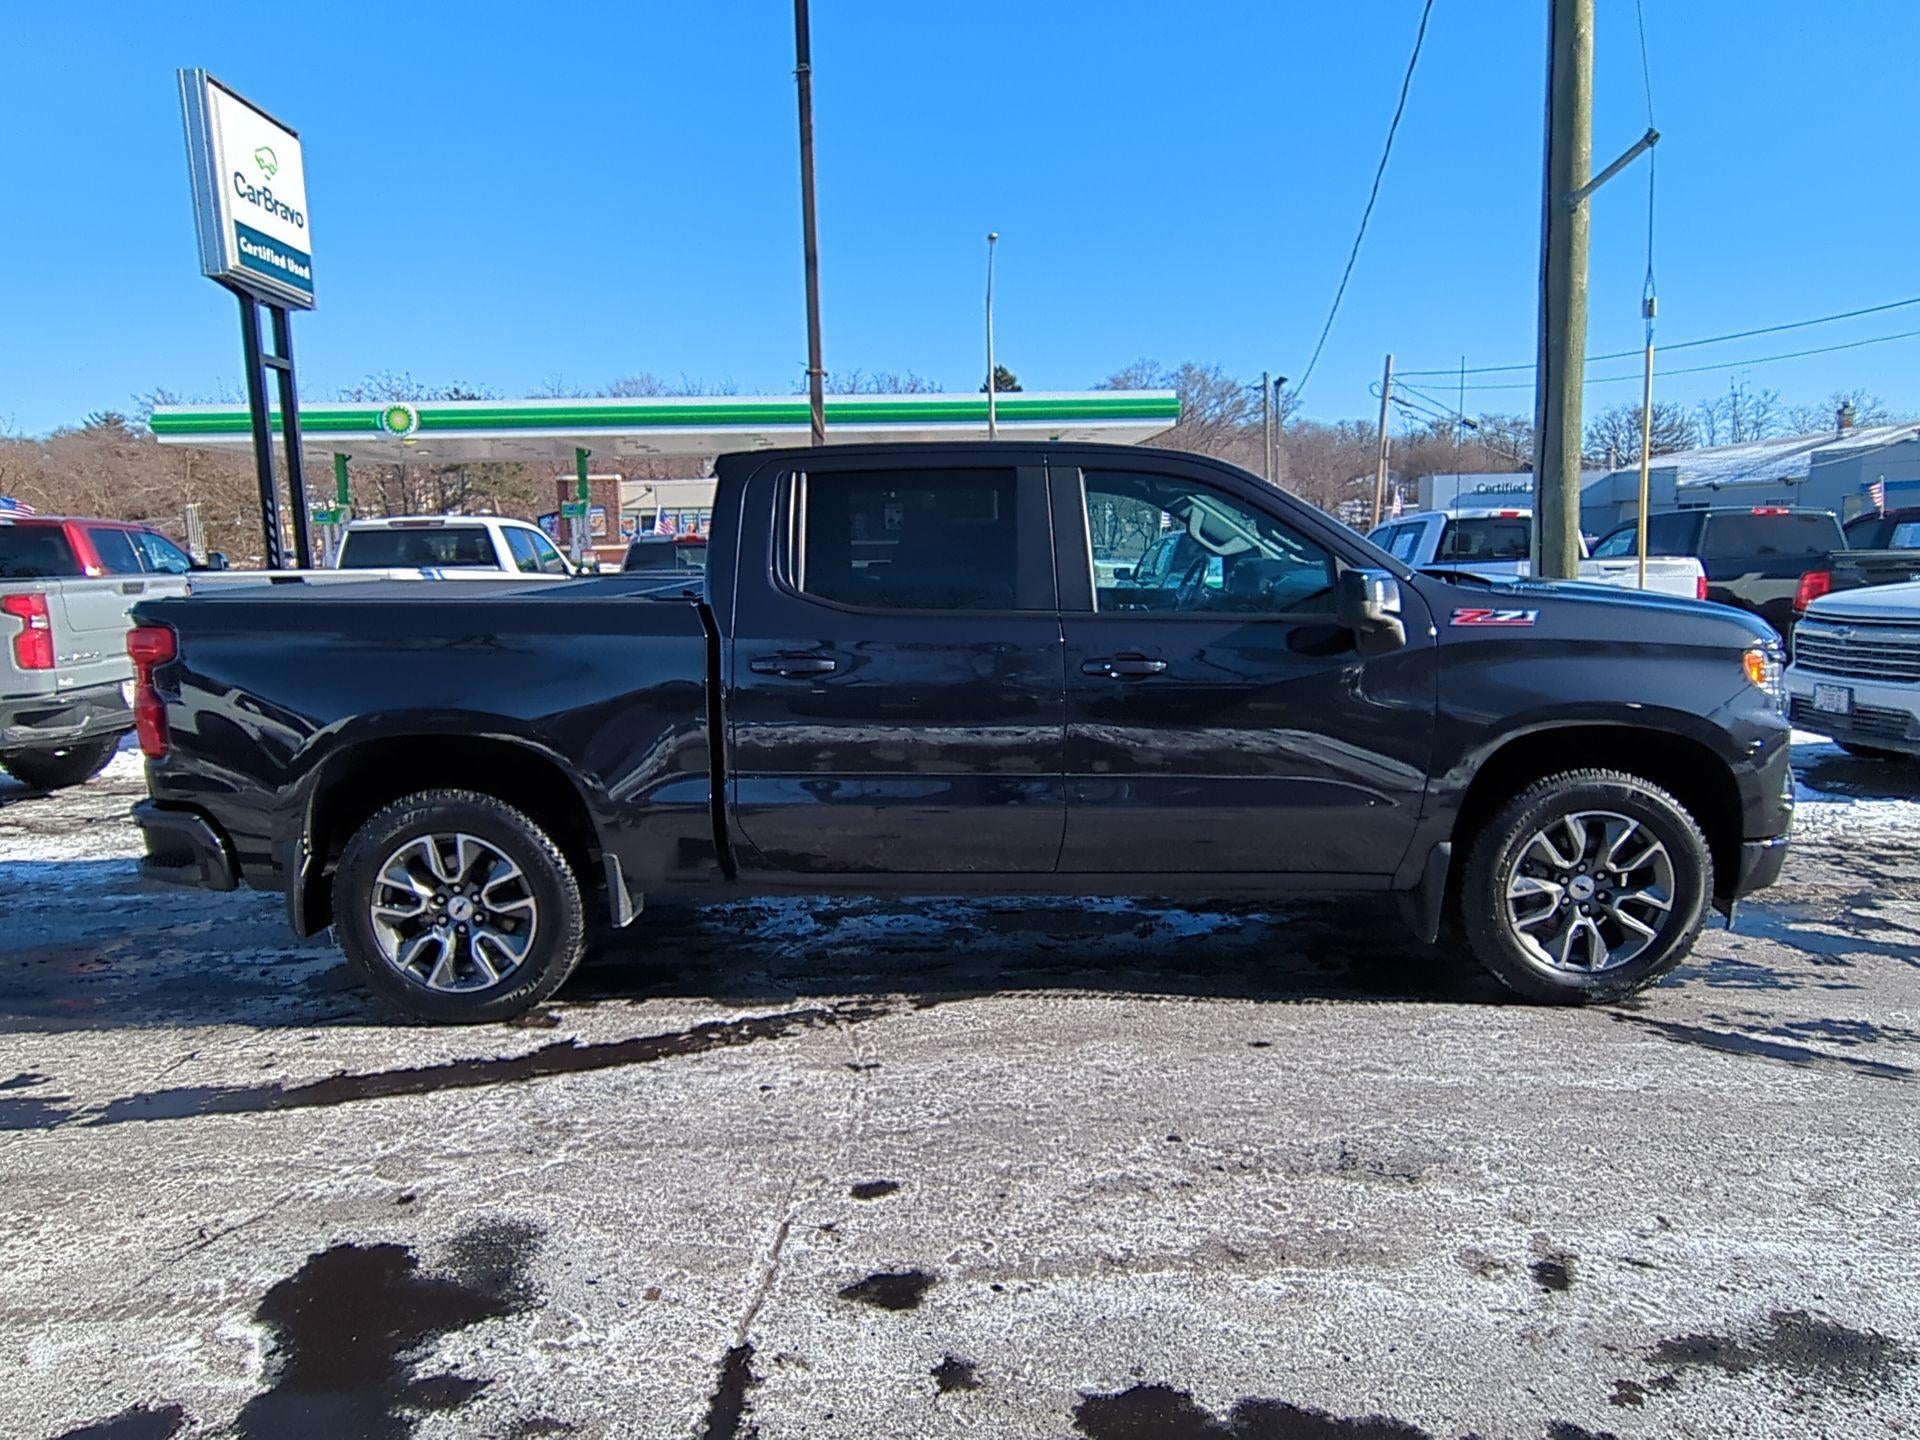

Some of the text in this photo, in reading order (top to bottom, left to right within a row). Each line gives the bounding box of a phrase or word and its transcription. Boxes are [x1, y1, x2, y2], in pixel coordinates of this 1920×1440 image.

[233, 171, 304, 229] CarBravo
[239, 236, 311, 280] Certified Used
[1476, 482, 1528, 495] Certified
[1449, 607, 1540, 627] Z71
